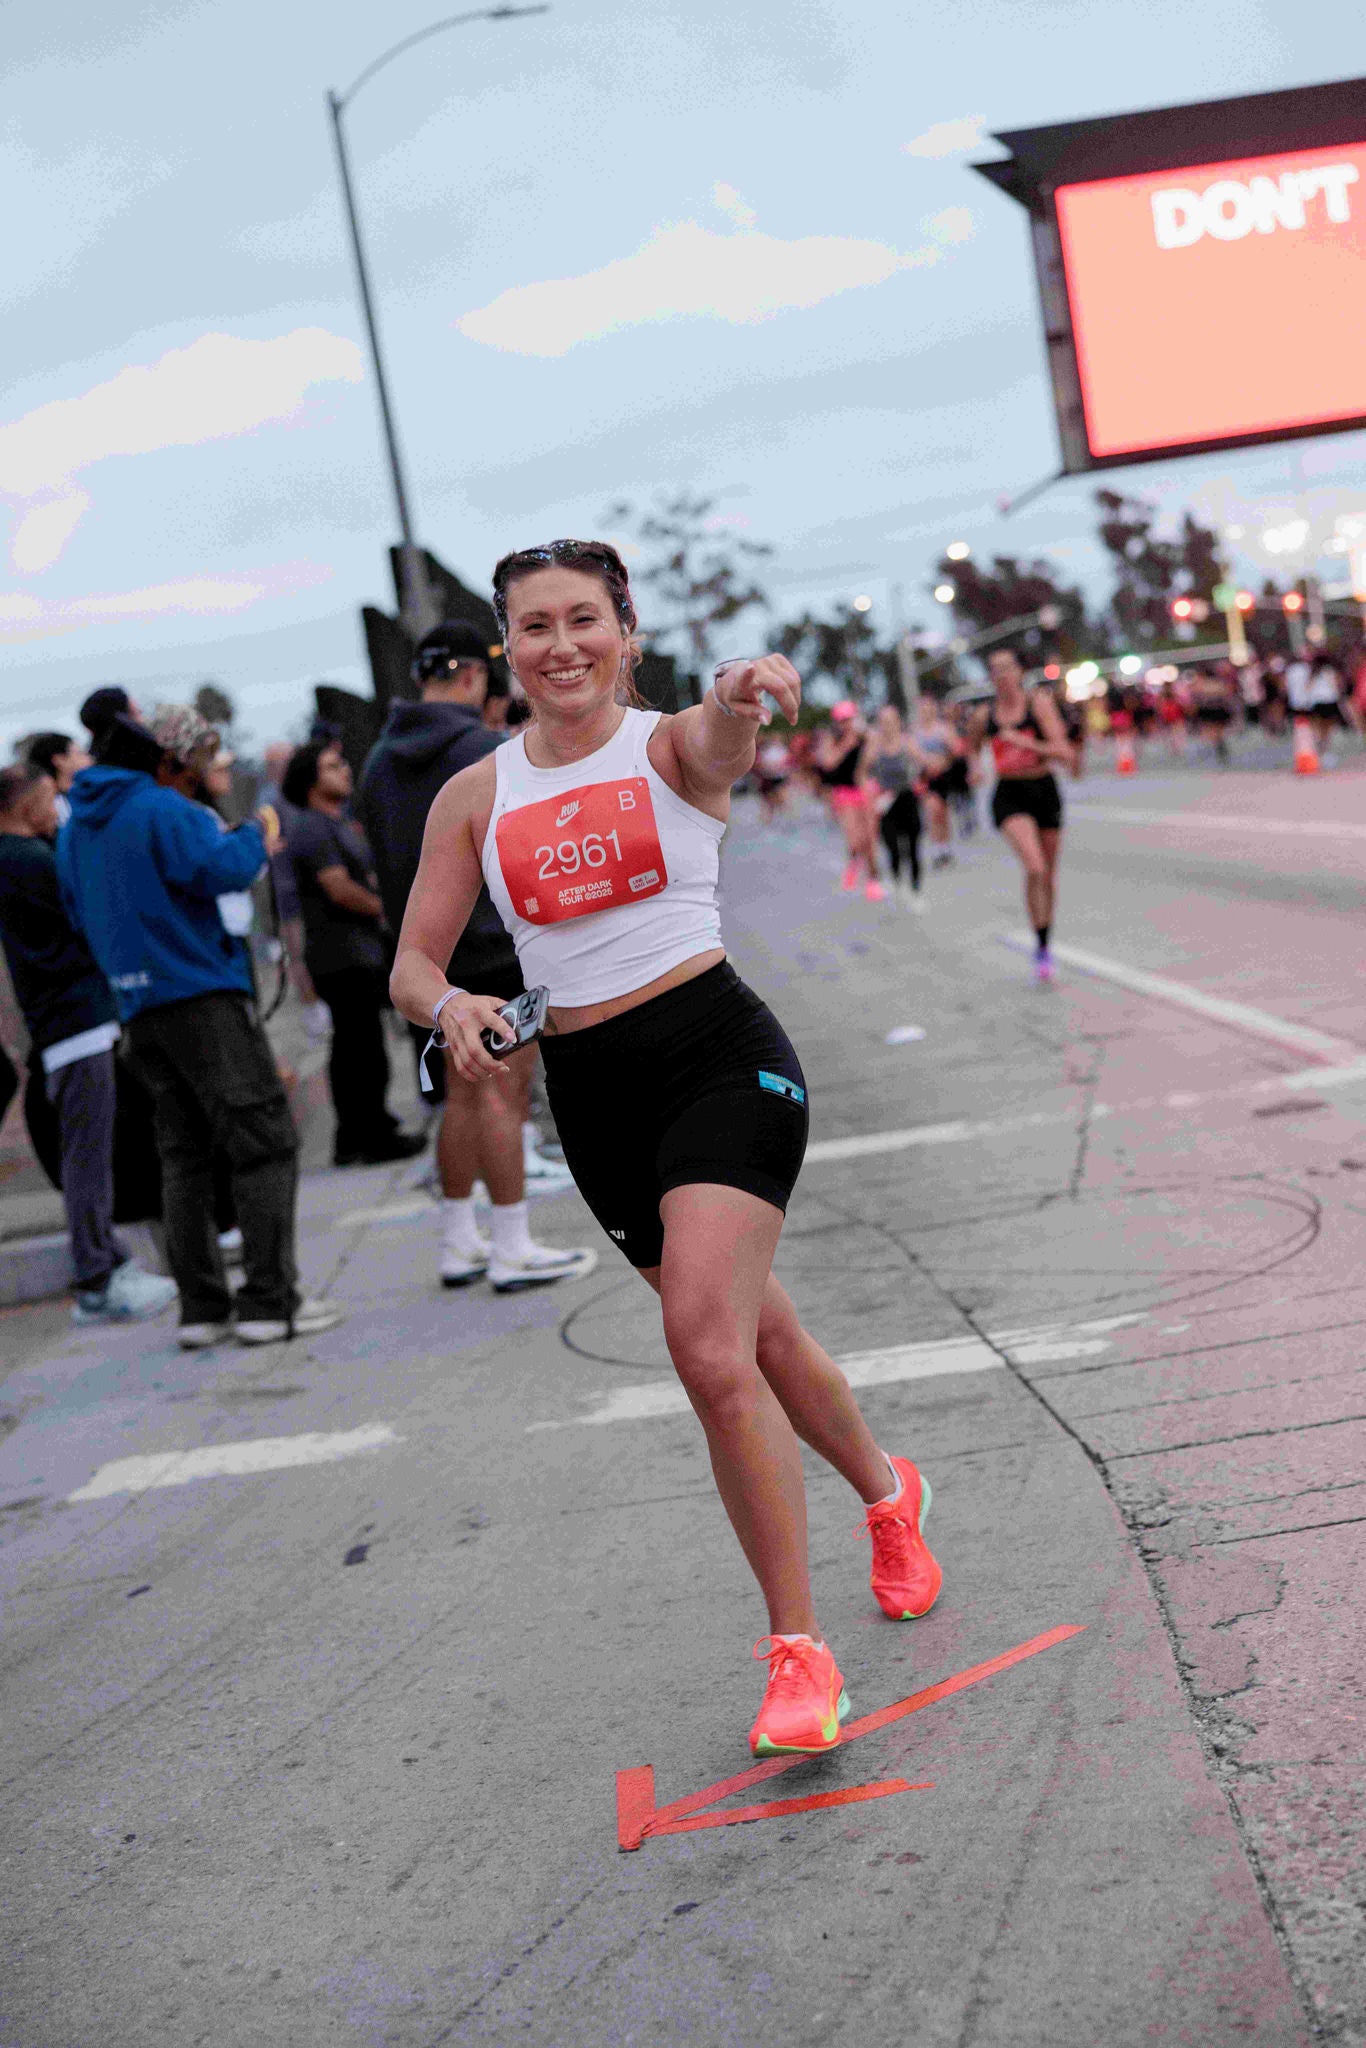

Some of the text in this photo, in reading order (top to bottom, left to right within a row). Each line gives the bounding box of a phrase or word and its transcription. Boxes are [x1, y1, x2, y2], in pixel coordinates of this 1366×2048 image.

[1151, 162, 1360, 249] DON'T
[561, 800, 579, 817] RUN
[618, 790, 636, 811] B
[534, 829, 623, 880] 2961
[558, 879, 613, 899] AFTER DARK
[559, 895, 583, 906] TOUR
